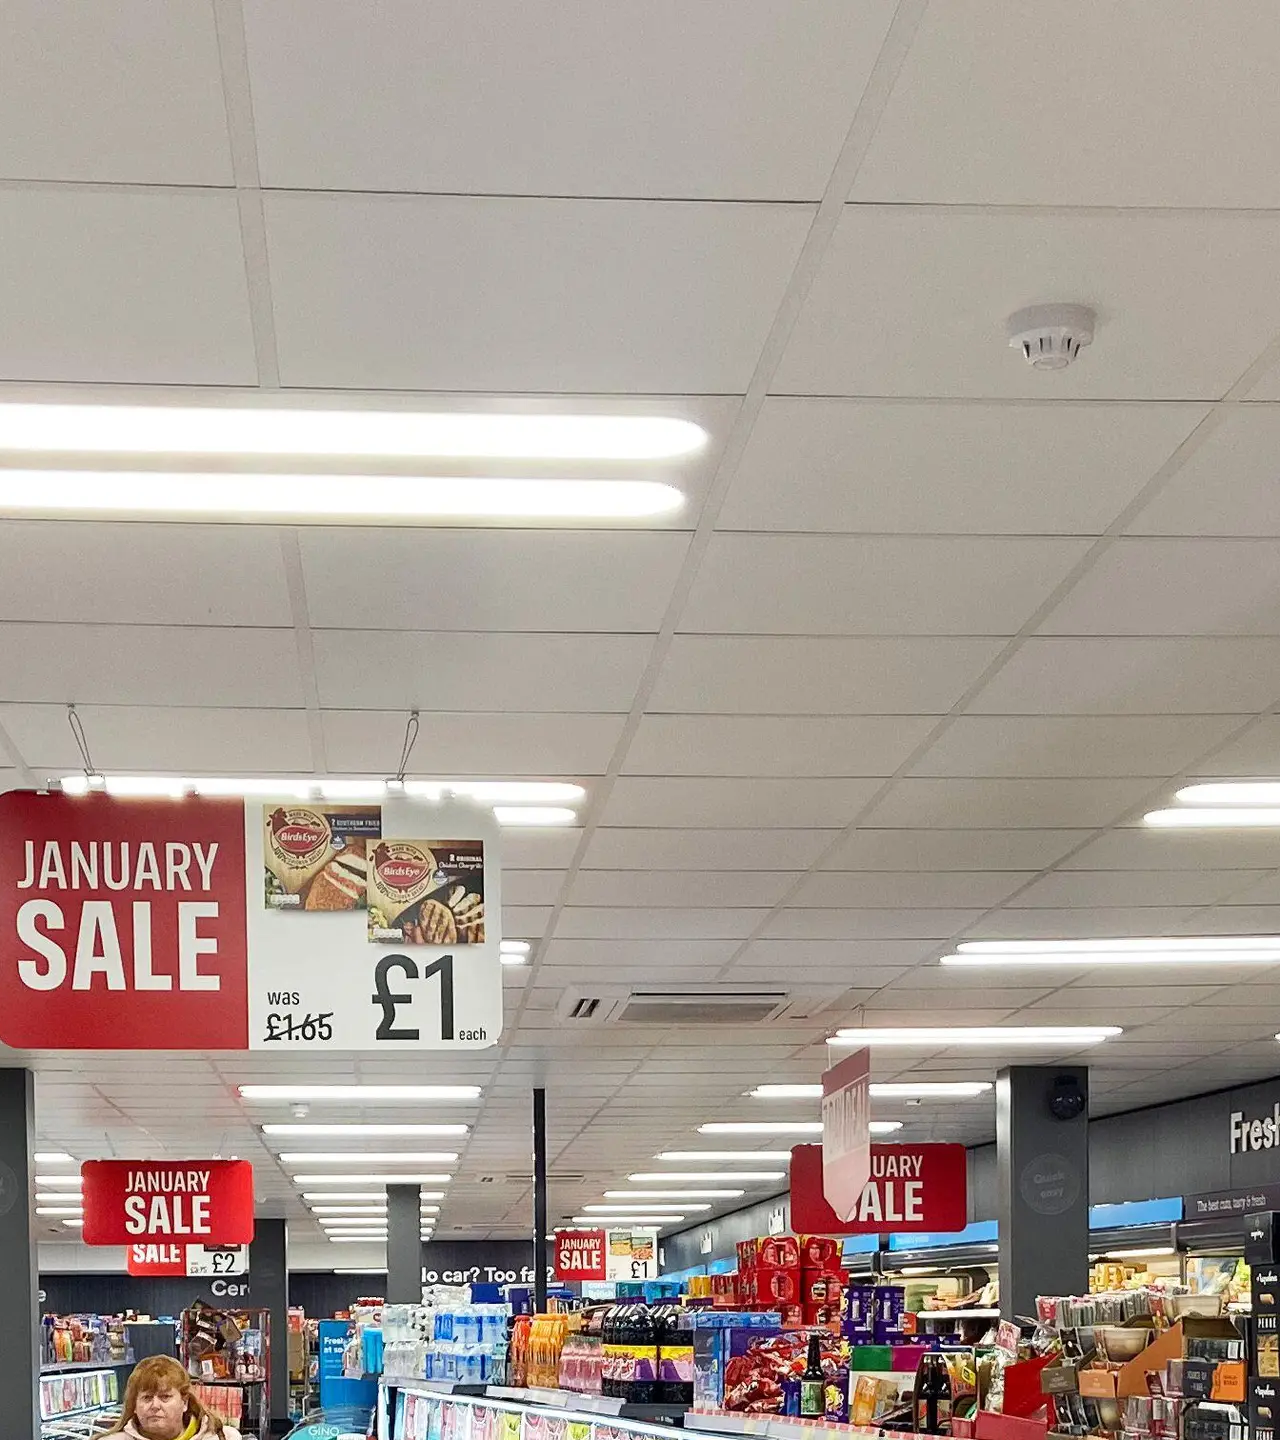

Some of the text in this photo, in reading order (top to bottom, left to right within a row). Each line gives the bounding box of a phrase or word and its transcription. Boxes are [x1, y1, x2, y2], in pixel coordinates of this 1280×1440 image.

[17, 841, 219, 891] JANUARY
[383, 866, 420, 877] BirdsEye
[17, 899, 220, 991] SALE
[267, 990, 300, 1005] was
[372, 953, 486, 1042] £1 each
[264, 1012, 333, 1041] £1.65
[870, 1155, 923, 1177] UARY
[125, 1171, 210, 1193] JANUARY
[846, 1181, 923, 1222] ALE
[125, 1195, 211, 1234] SALE
[133, 1244, 180, 1263] SALE
[560, 1238, 601, 1250] JANUARY
[211, 1253, 235, 1274] £2
[560, 1250, 601, 1270] SALE
[630, 1261, 649, 1279] £1
[442, 1267, 481, 1283] car?
[483, 1267, 516, 1284] Too
[520, 1267, 556, 1284] fa?
[308, 1426, 340, 1437] GINO
